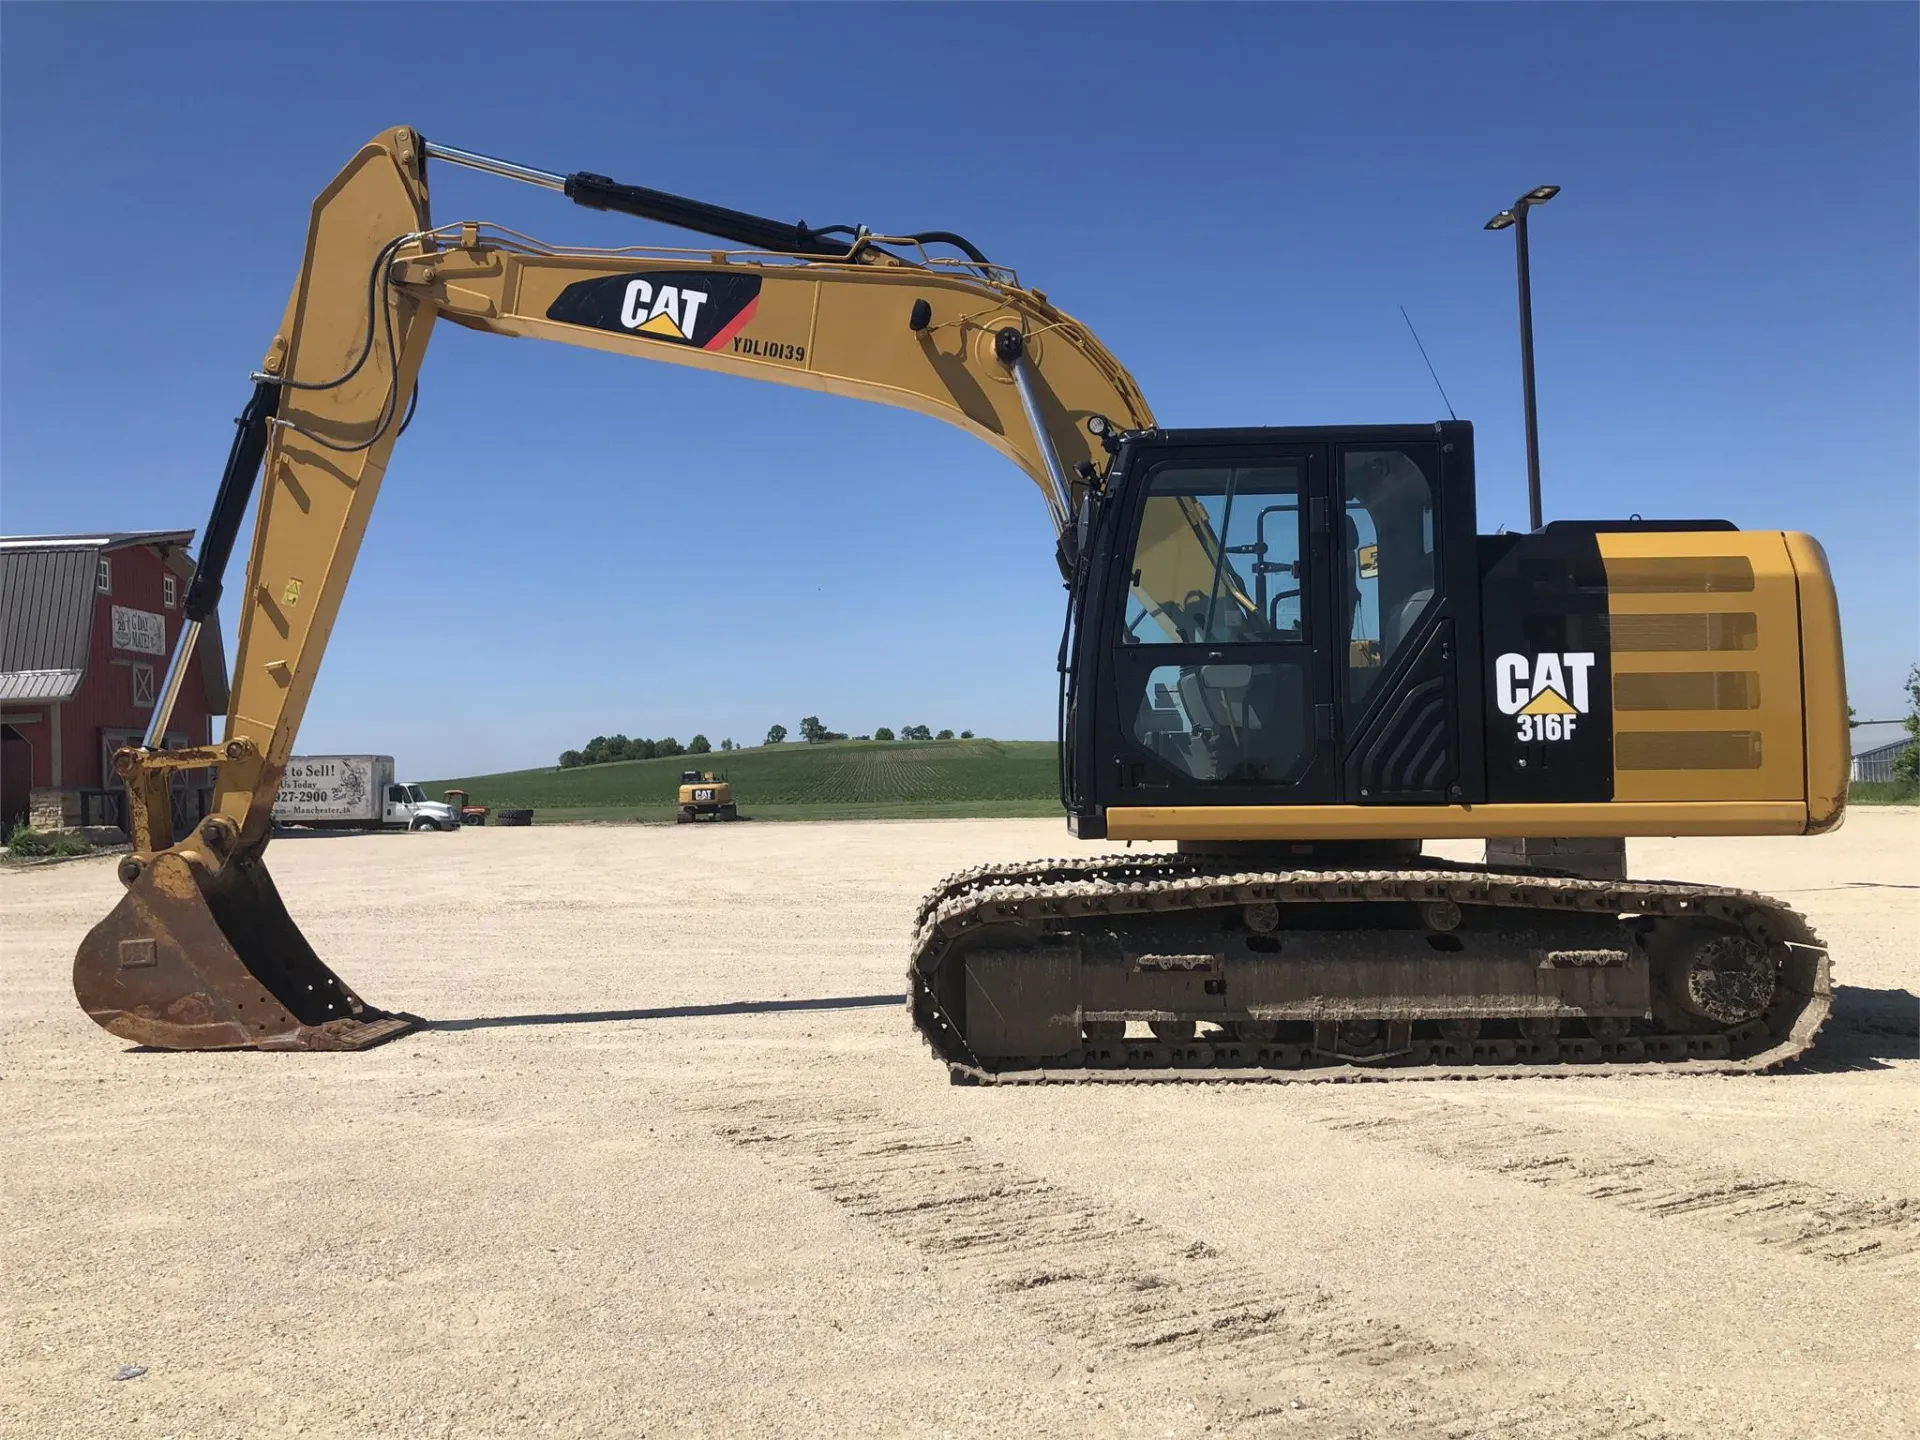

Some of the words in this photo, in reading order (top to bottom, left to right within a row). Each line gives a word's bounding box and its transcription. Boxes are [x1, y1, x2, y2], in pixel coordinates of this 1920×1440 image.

[620, 279, 708, 340] CAT
[733, 337, 805, 362] YDL10139
[1495, 652, 1595, 715] CAT
[1517, 714, 1577, 742] 316F
[291, 767, 303, 777] to
[305, 764, 335, 777] Sell!
[280, 780, 291, 789] Us
[293, 780, 317, 790] Today
[695, 789, 712, 800] CAT
